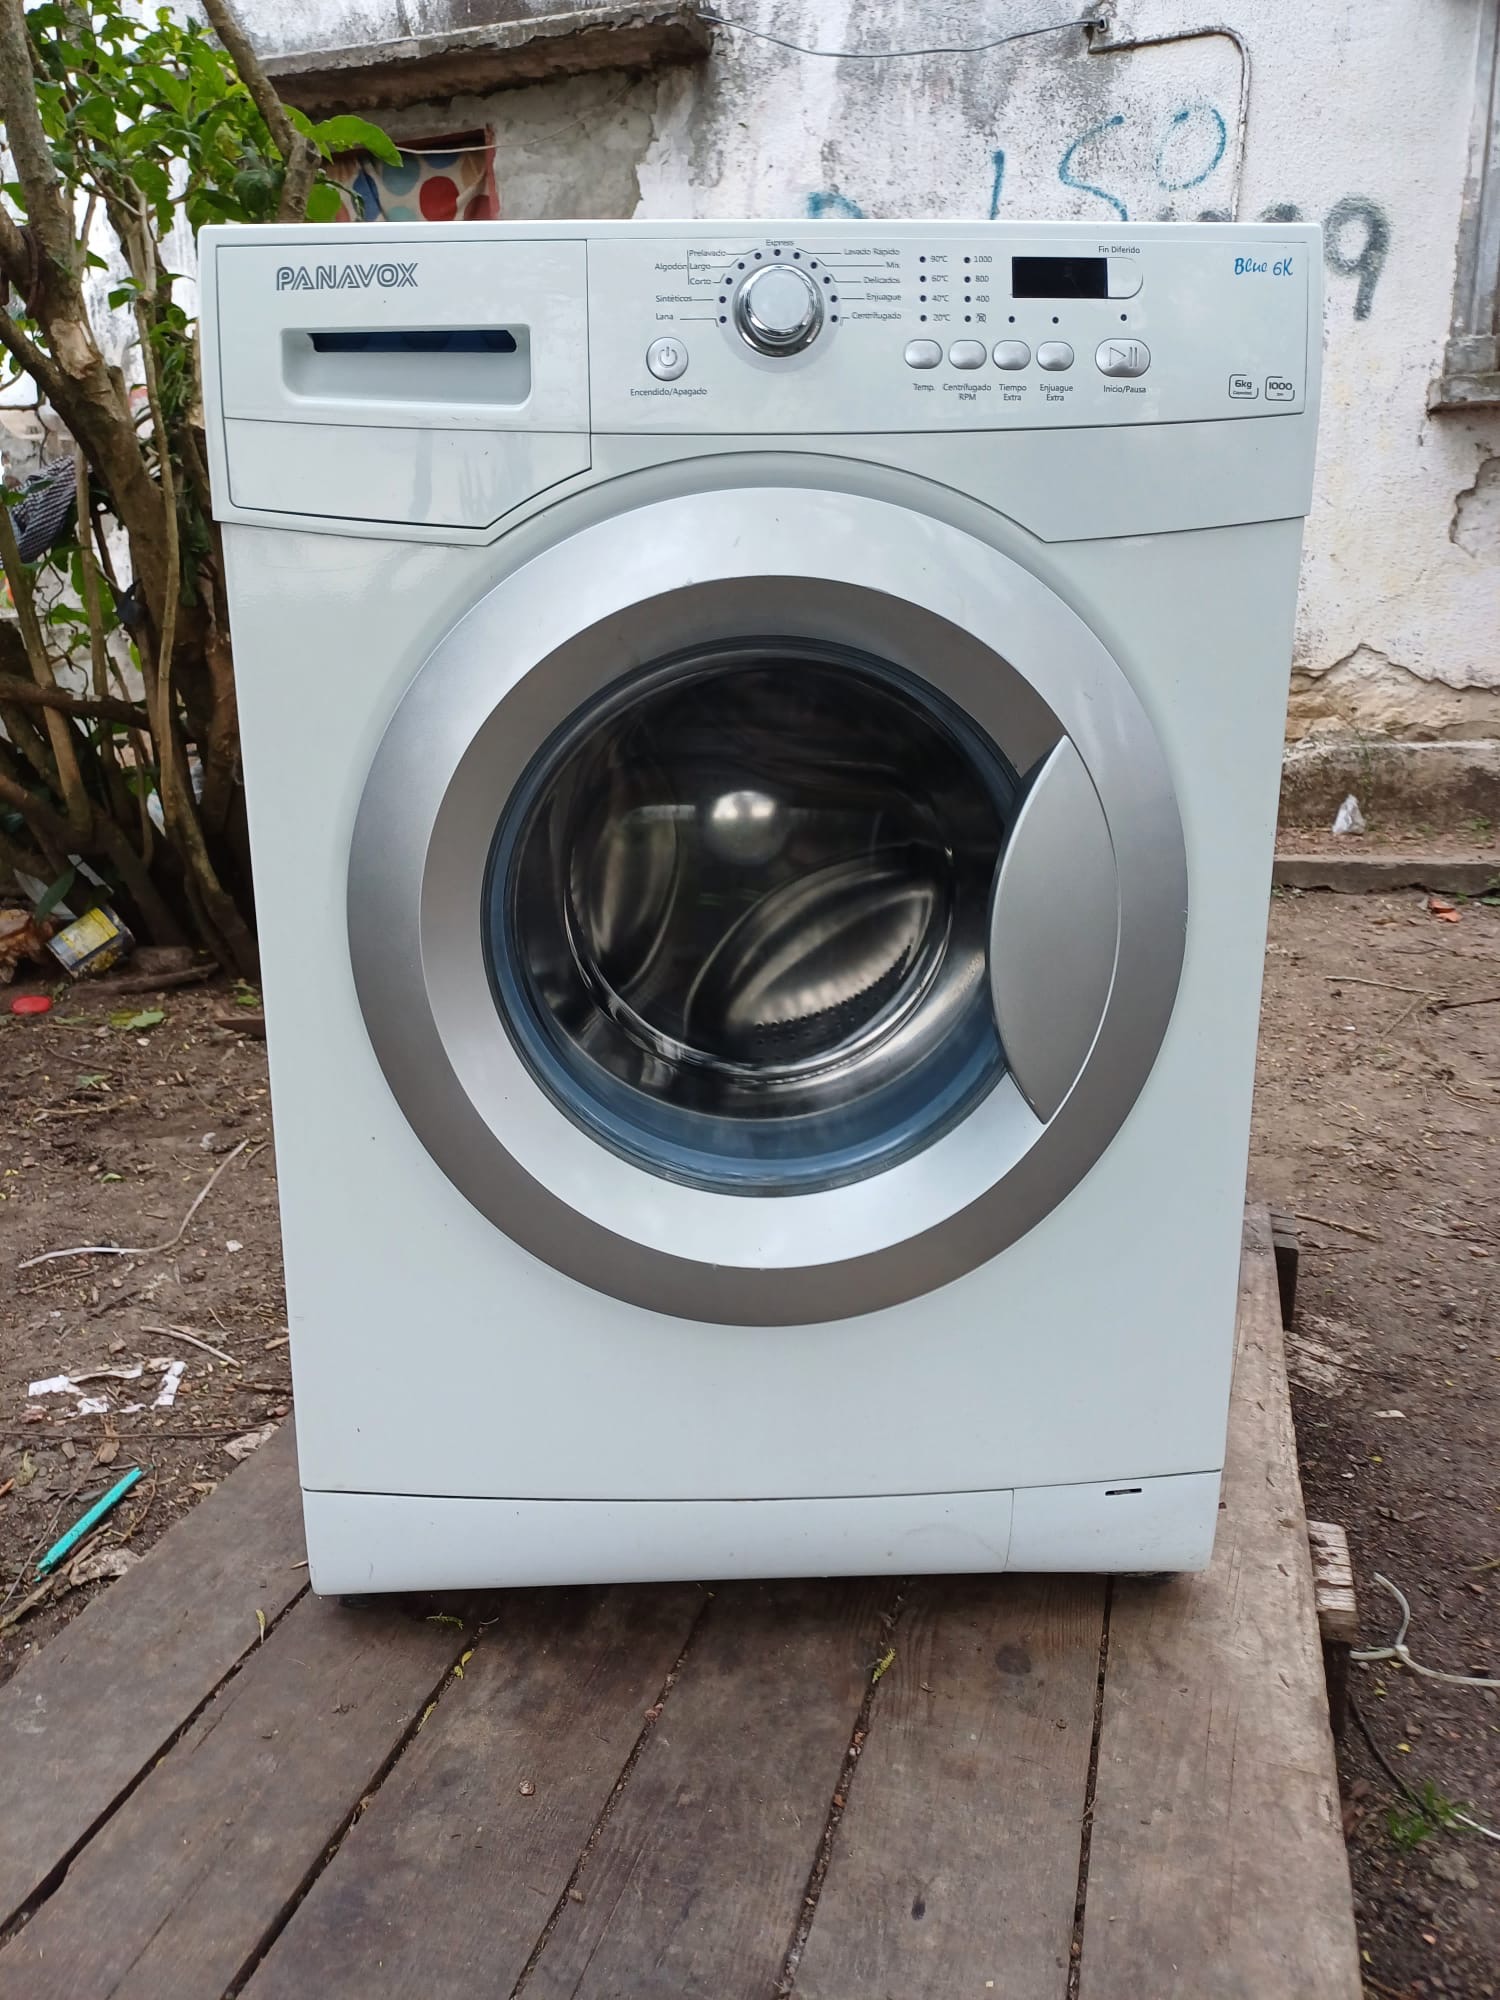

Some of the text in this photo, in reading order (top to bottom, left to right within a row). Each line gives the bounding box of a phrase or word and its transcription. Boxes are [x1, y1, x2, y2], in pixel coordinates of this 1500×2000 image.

[1111, 246, 1140, 254] Diferido
[689, 262, 711, 271] Largo
[1234, 257, 1294, 276] Blue 6K
[276, 262, 418, 291] PANAVOX
[689, 277, 712, 285] Corto
[655, 312, 674, 320] Lana
[943, 383, 992, 393] Centrifugado
[999, 384, 1027, 394] Tiempo
[1039, 384, 1074, 394] Enjuague
[1103, 384, 1147, 394] Inicio/Pausa
[1234, 379, 1252, 390] 6kg
[1269, 381, 1293, 391] 1000
[630, 387, 708, 397] Encendido/Apagado
[959, 393, 977, 401] RPM
[1003, 393, 1022, 401] Extra
[1046, 394, 1065, 402] Extra
